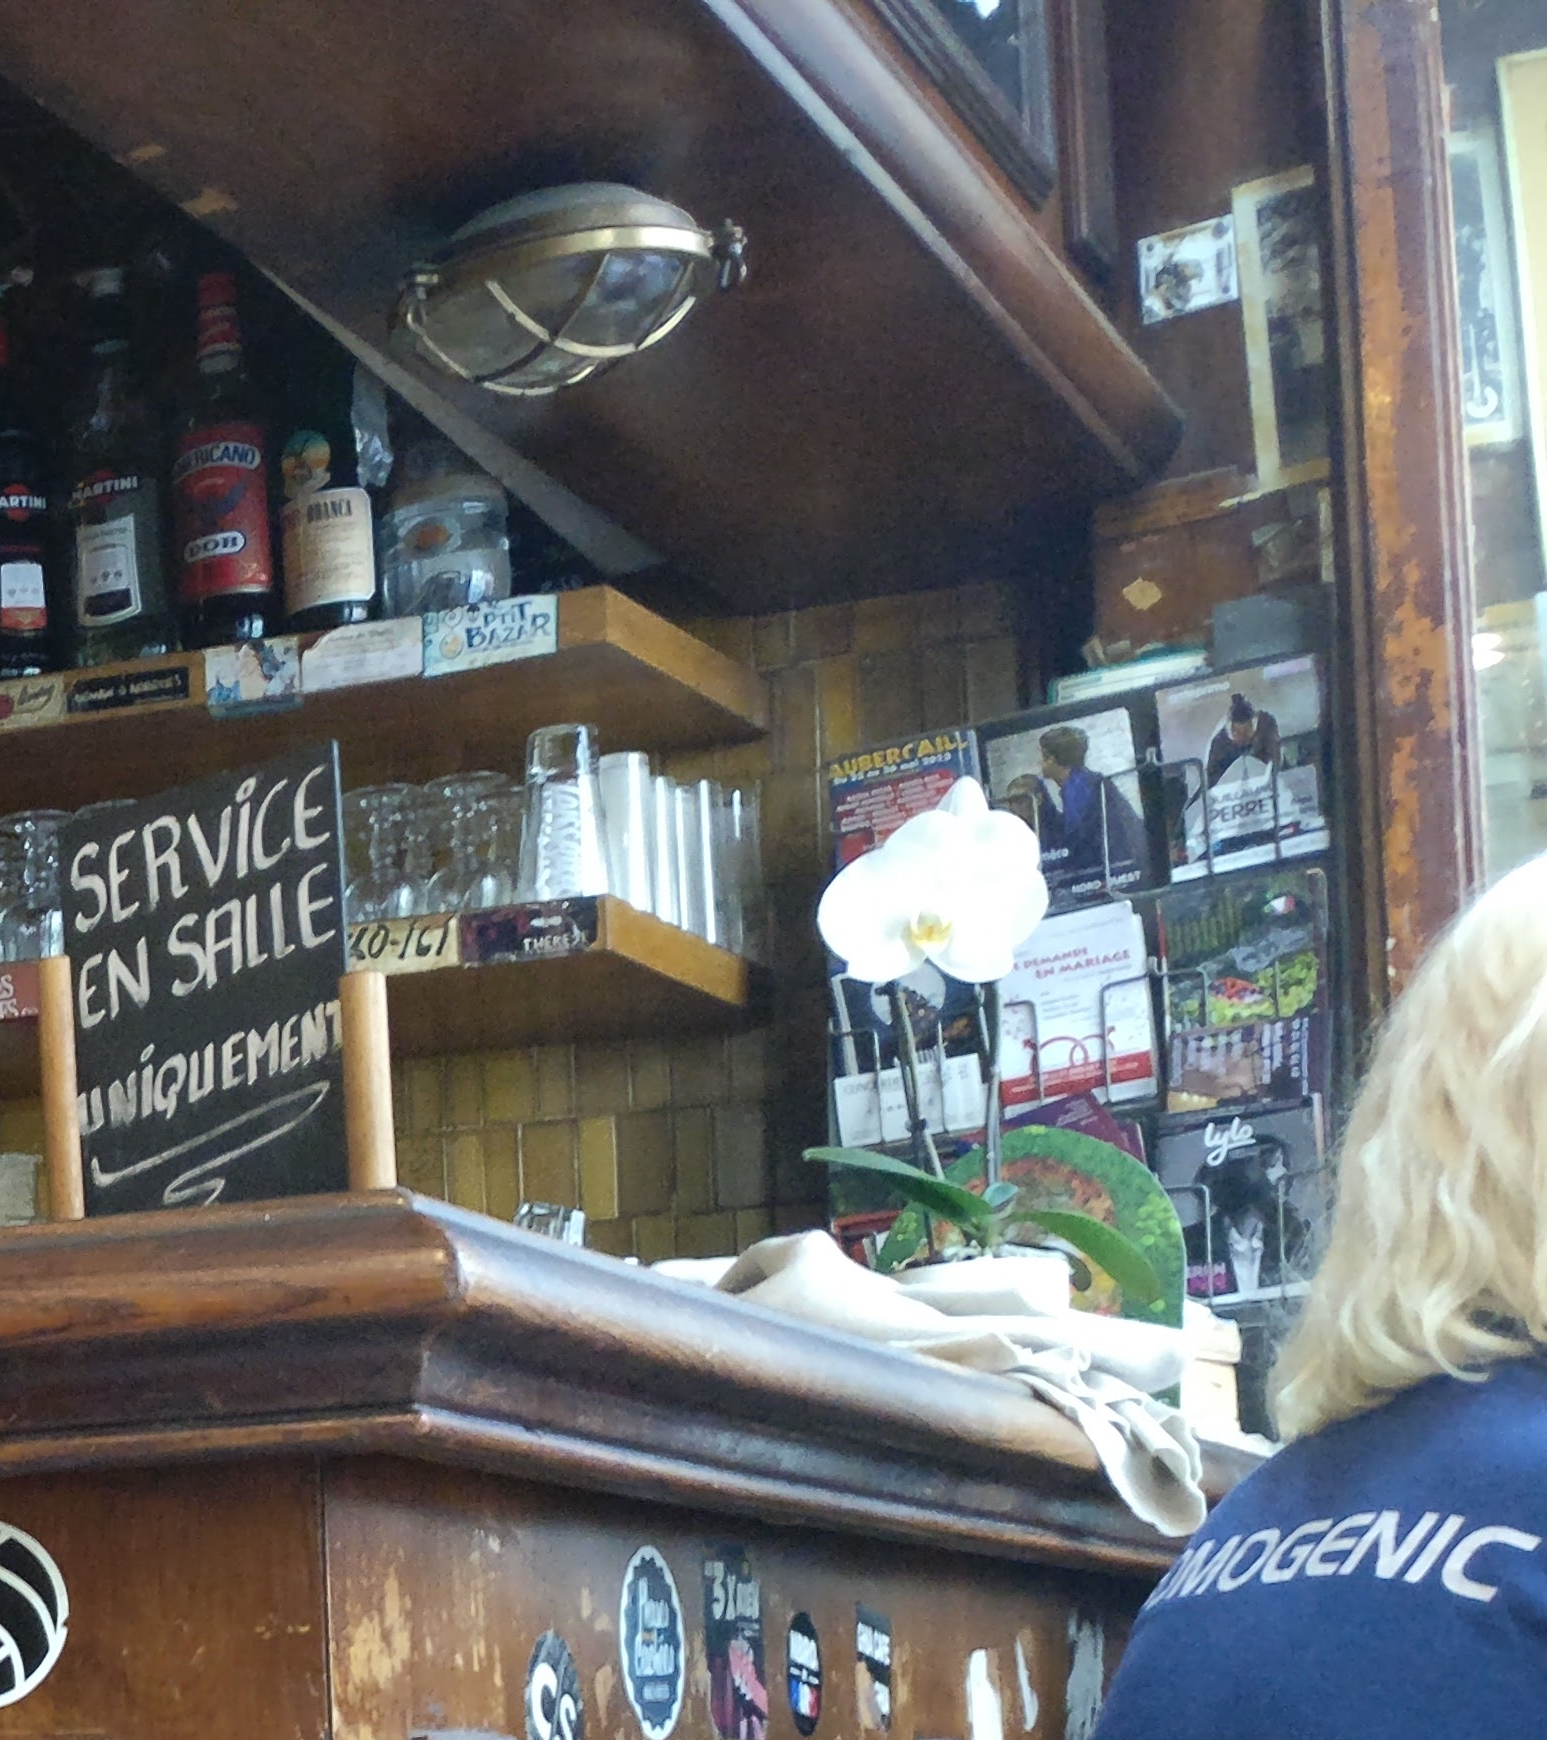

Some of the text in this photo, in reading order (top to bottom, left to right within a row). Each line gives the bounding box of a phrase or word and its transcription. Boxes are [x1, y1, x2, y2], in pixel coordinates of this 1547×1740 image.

[71, 474, 138, 501] MARTINI
[465, 612, 551, 649] BAZAR
[79, 862, 337, 1030] EN SALLE
[1023, 946, 1089, 970] DEMANDE
[1036, 949, 1131, 979] EN MARIAGE
[1144, 1508, 1542, 1610] OMOGENIC
